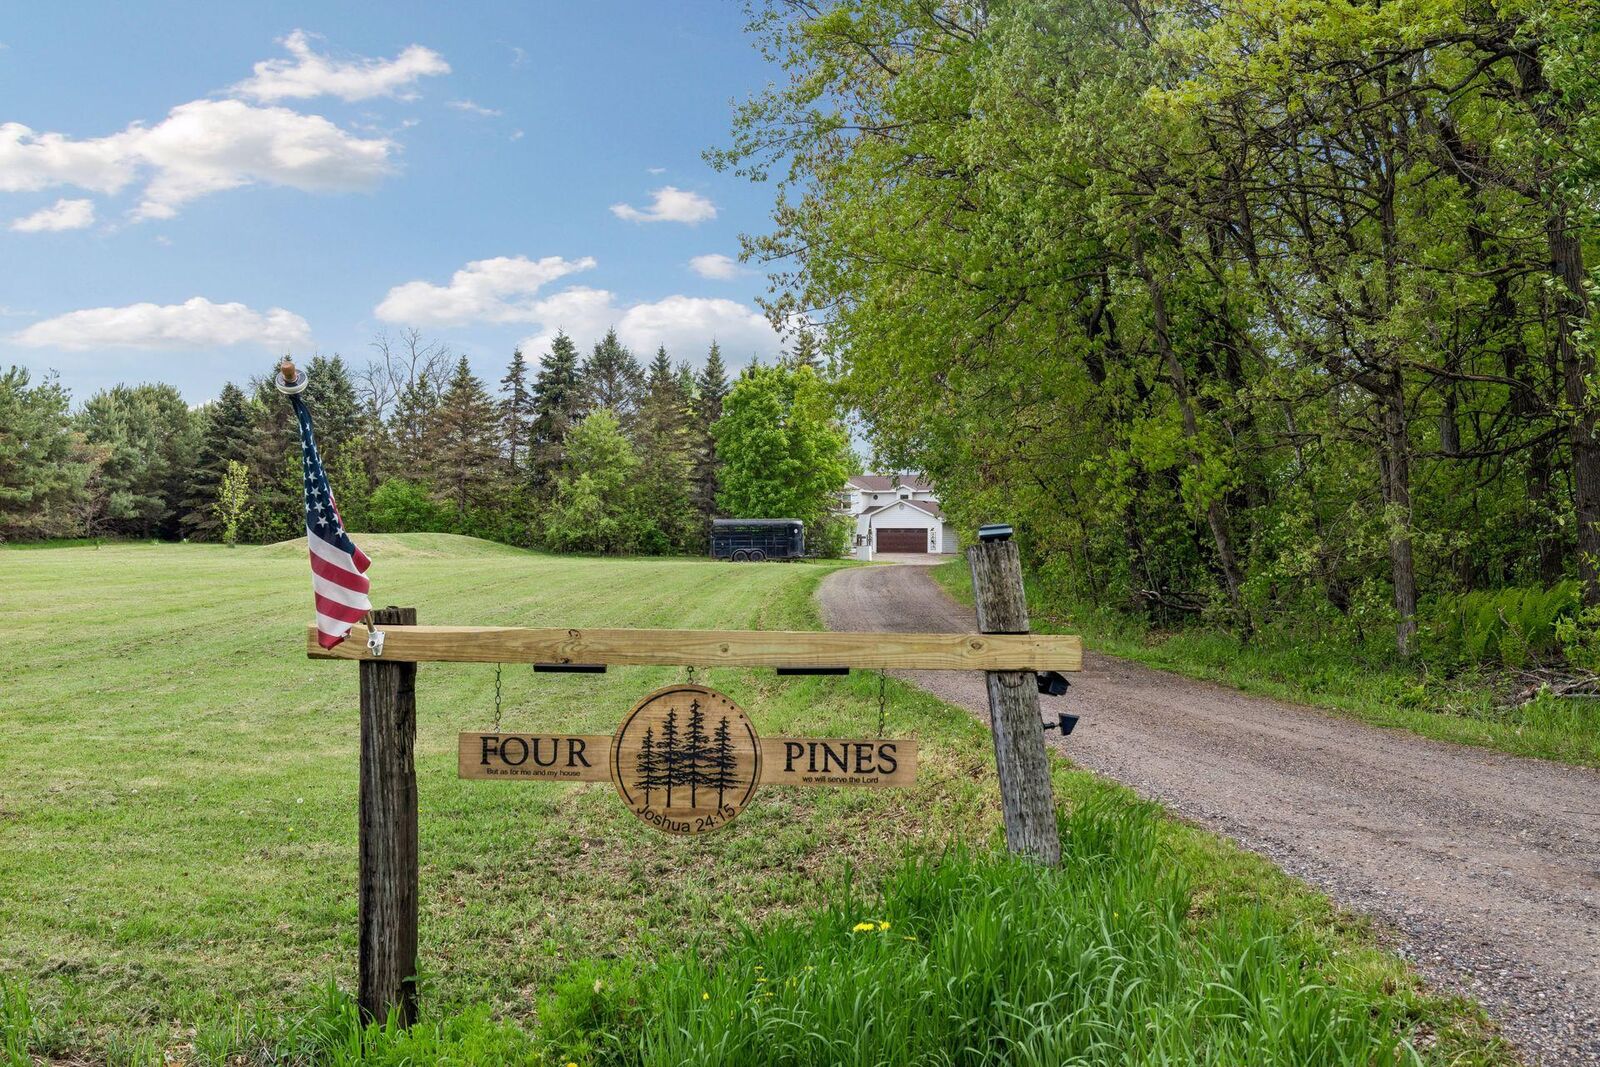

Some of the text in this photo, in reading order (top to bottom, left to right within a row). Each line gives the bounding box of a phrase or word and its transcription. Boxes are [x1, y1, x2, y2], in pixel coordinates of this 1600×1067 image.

[480, 736, 592, 767] FOUR
[783, 742, 898, 774] PINES
[547, 770, 558, 778] my
[559, 769, 581, 777] house
[637, 803, 735, 832] Joshua 24:15
